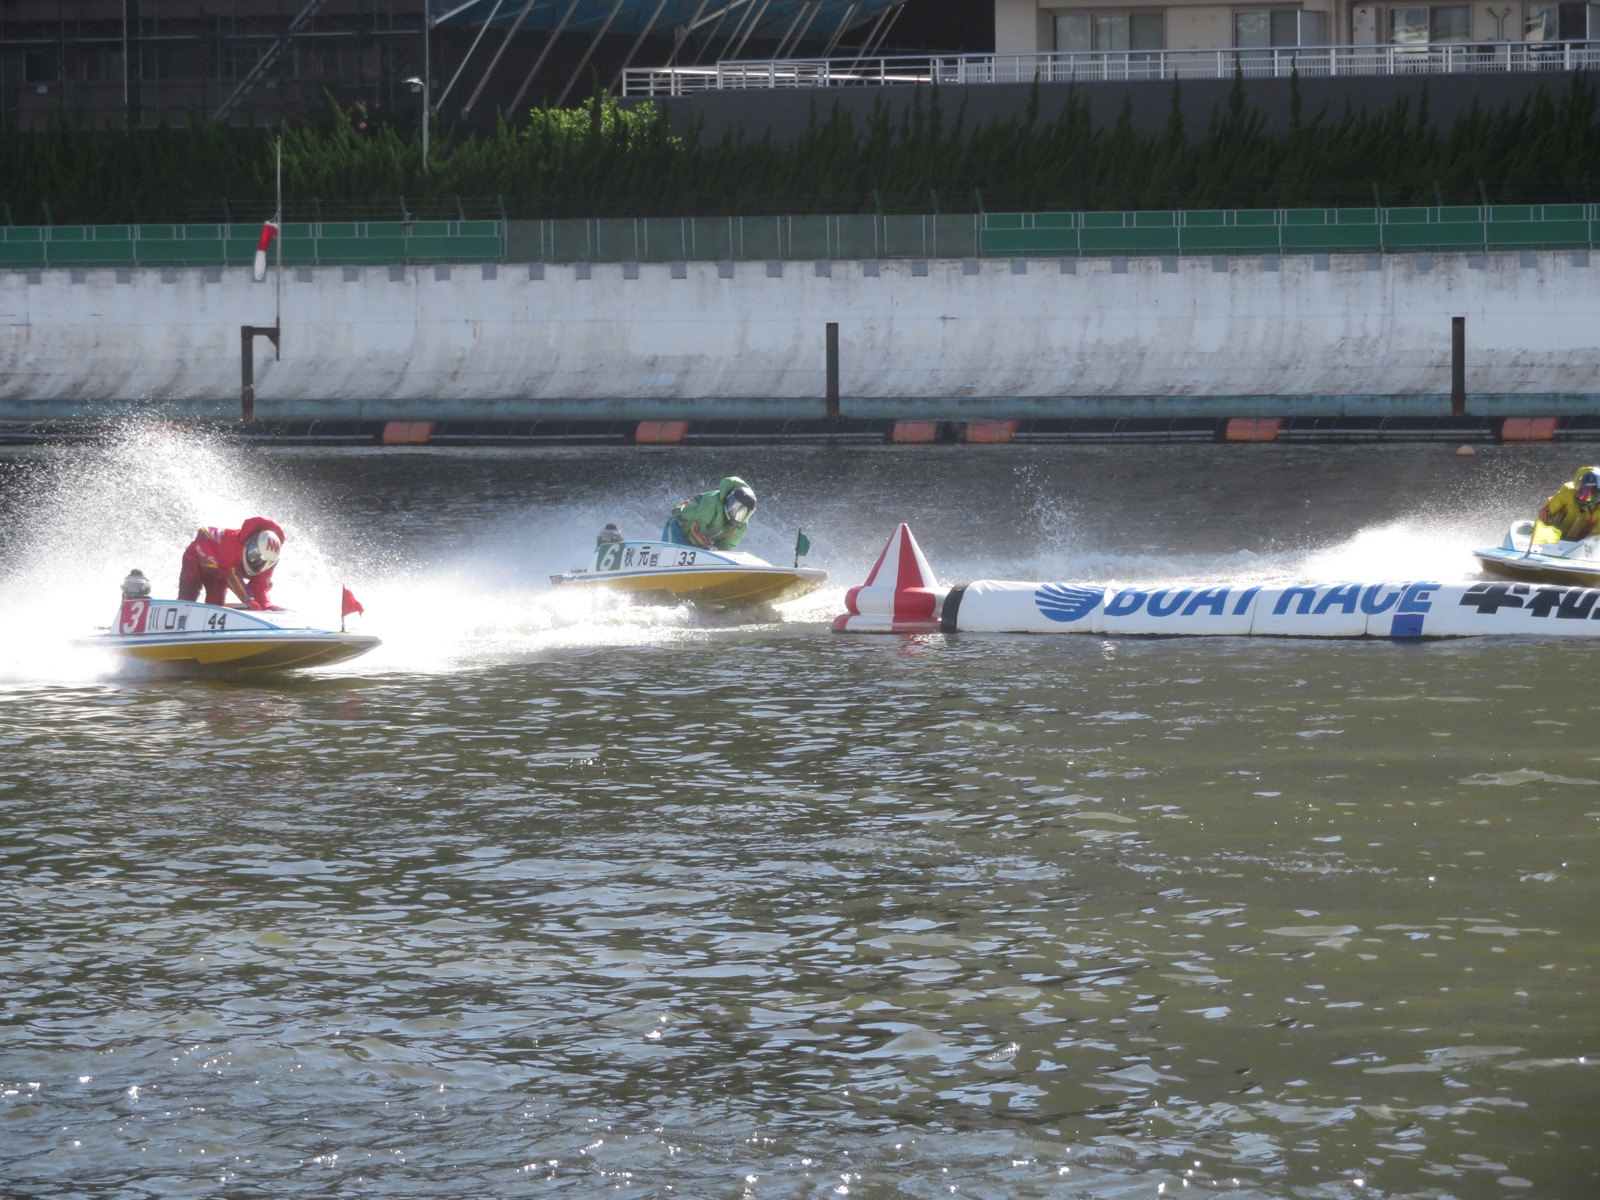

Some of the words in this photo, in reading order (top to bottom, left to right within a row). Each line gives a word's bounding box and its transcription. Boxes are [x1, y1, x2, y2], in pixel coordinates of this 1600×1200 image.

[600, 544, 620, 571] 6
[678, 551, 697, 566] 33
[122, 601, 145, 634] 3
[207, 612, 228, 630] 44
